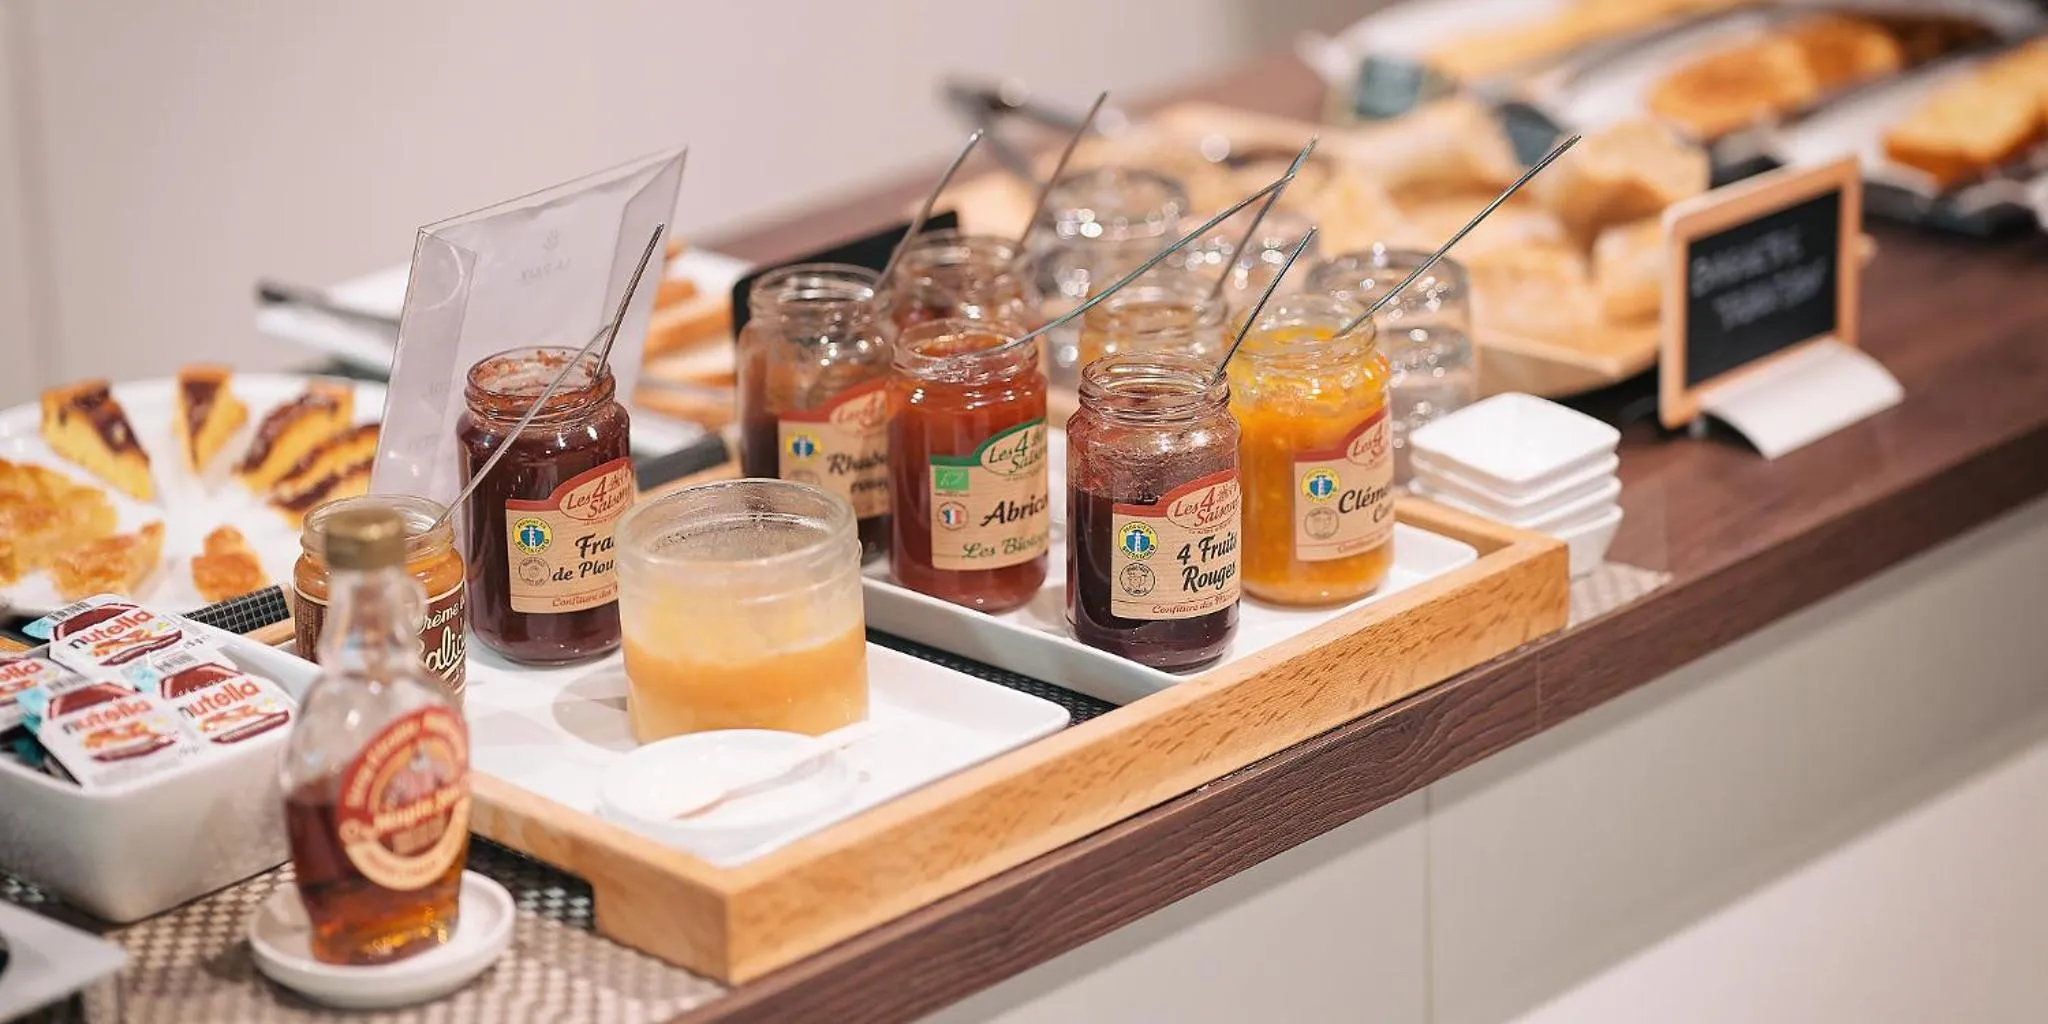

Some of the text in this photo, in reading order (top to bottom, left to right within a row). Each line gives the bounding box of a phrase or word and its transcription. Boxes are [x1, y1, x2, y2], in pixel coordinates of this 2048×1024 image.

[989, 430, 1029, 464] Les 4
[566, 476, 608, 511] Les 4
[1174, 486, 1216, 518] Les 4
[961, 541, 997, 559] Les
[1177, 531, 1238, 566] 4 Fruits
[552, 565, 574, 582] de
[1181, 561, 1236, 594] Rouges
[1152, 601, 1199, 615] Confiture
[68, 610, 155, 650] nutella
[177, 679, 261, 719] nutella
[61, 699, 153, 735] nutella
